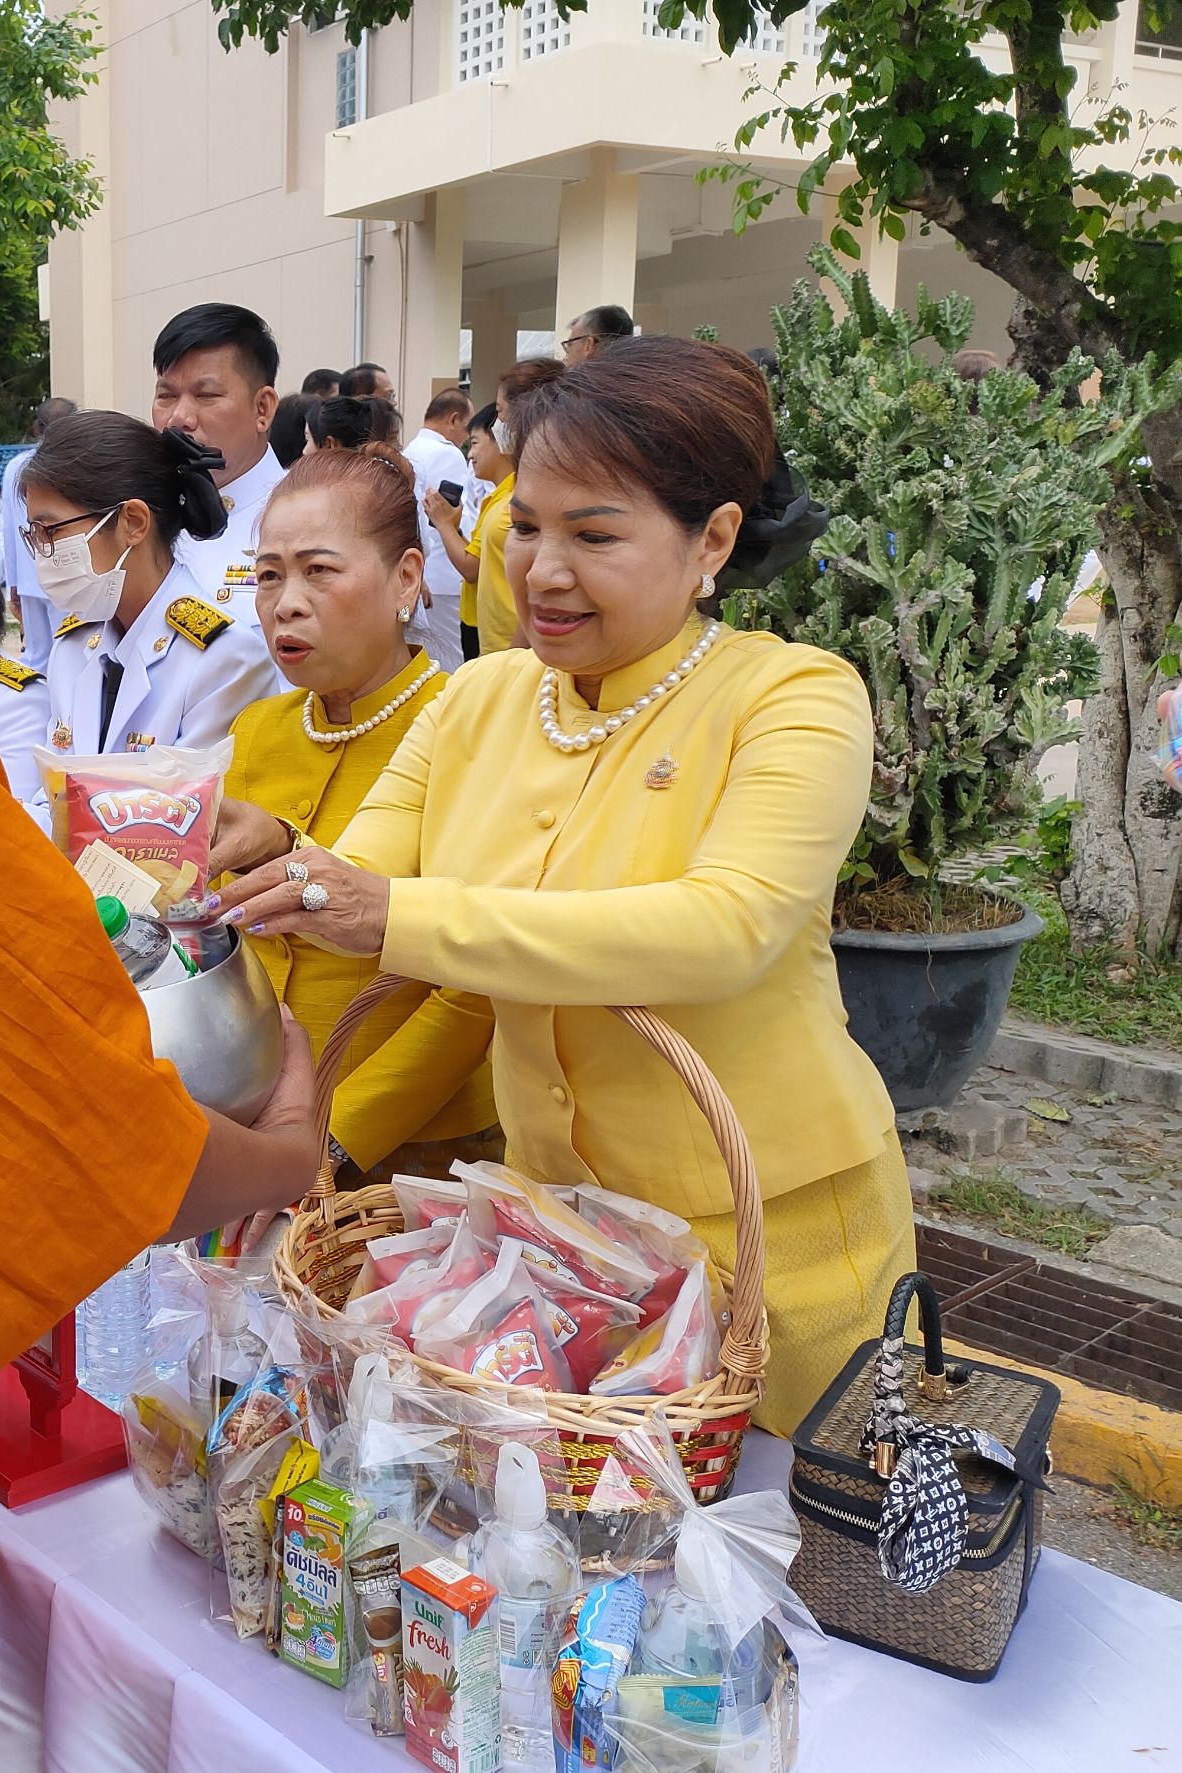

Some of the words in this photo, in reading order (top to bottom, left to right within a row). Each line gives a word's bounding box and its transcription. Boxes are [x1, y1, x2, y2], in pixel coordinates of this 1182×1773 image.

[286, 1547, 338, 1588] ดัชมิลล์
[407, 1620, 452, 1660] fresh
